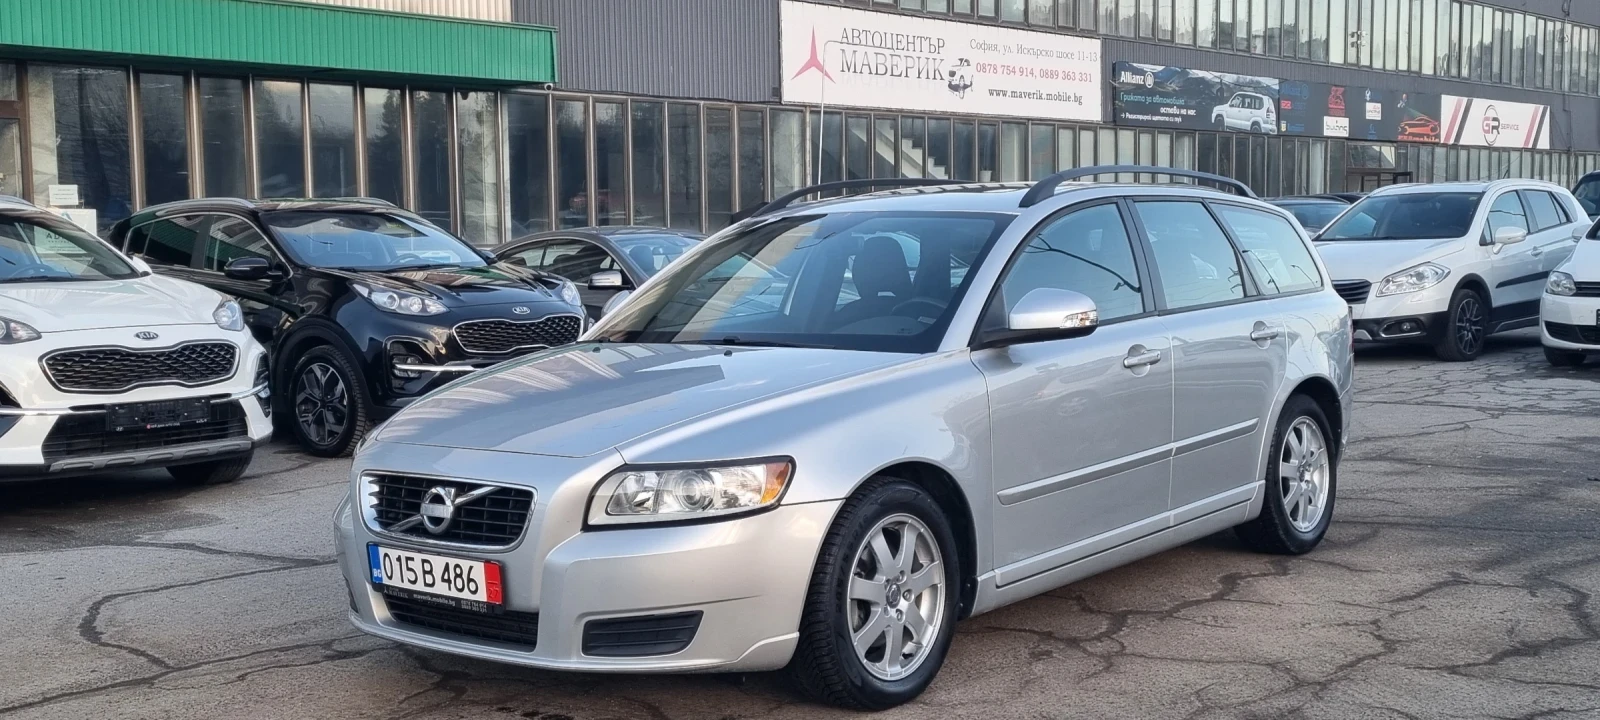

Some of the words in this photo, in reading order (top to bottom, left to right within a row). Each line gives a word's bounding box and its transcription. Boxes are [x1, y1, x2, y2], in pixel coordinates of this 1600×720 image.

[840, 27, 945, 54] АВТОЦЕНТЪР
[969, 38, 1000, 54] София,
[1002, 44, 1014, 55] ул.
[1016, 43, 1054, 59] Искърско
[1056, 49, 1075, 60] шосе
[1077, 50, 1098, 62] 11-13
[840, 48, 945, 81] МАВЕРИК
[976, 62, 998, 74] 0878
[1001, 64, 1017, 76] 754
[1019, 66, 1037, 79] 914,
[1040, 68, 1059, 79] 0889
[1061, 70, 1076, 81] 363
[1078, 72, 1092, 82] 331
[1120, 70, 1144, 84] Allianz
[988, 88, 1083, 105] www.maverik.mobile.bg
[1501, 123, 1519, 131] SERVICE
[373, 568, 382, 578] BG
